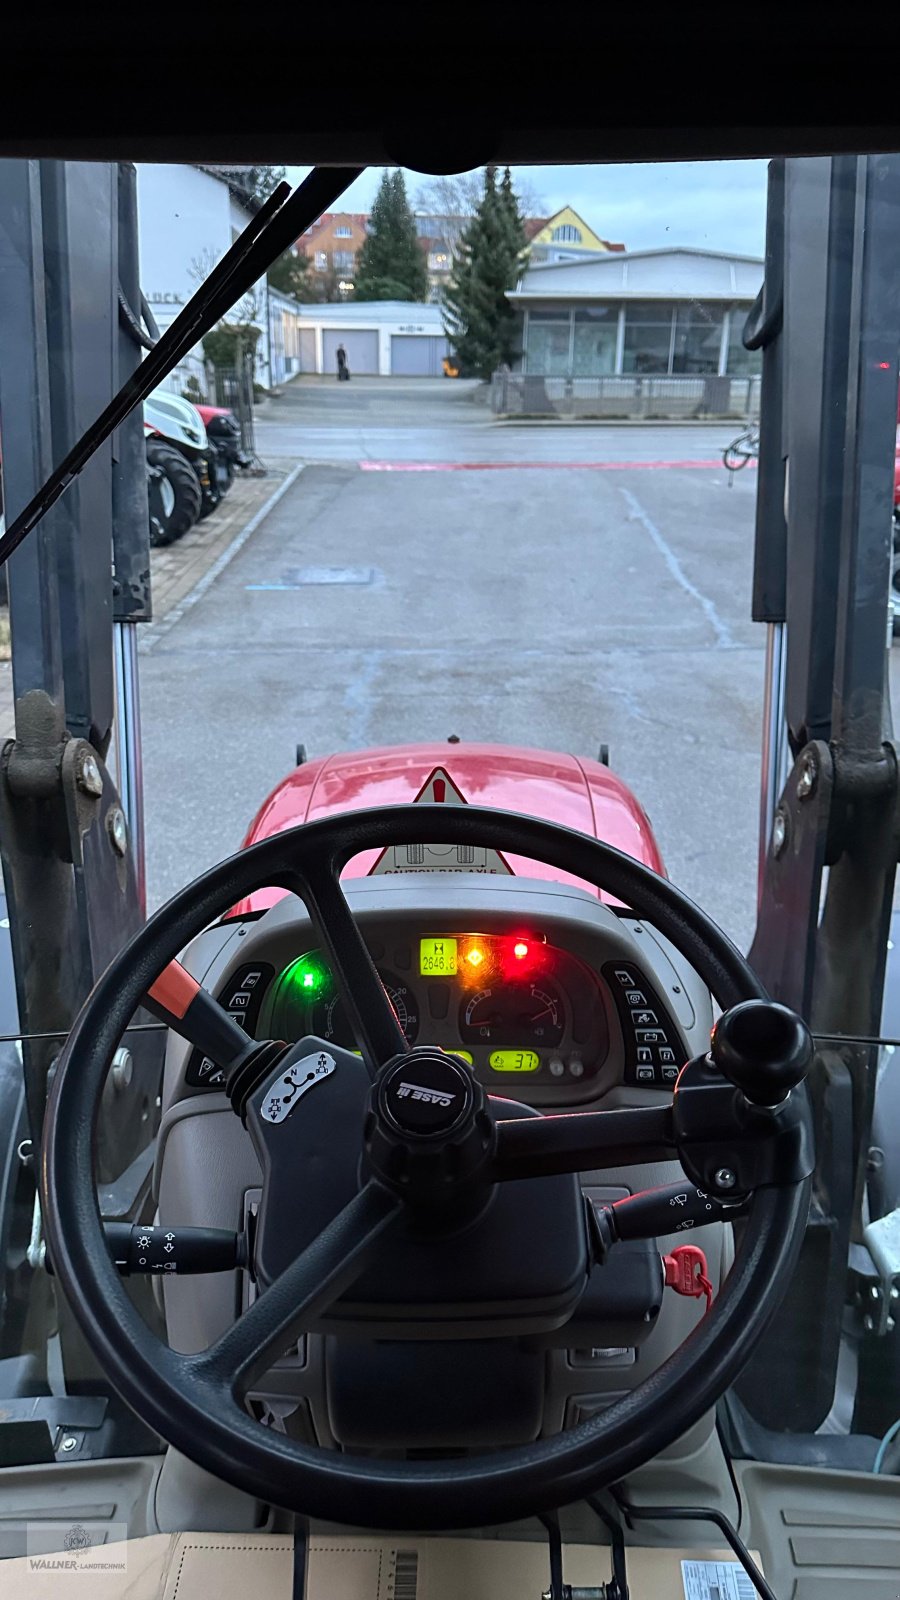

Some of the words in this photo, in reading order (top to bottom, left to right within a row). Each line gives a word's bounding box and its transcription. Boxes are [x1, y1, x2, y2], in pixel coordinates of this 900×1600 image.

[407, 1015, 417, 1023] 25
[290, 1068, 298, 1077] N
[411, 1090, 452, 1107] CASE
